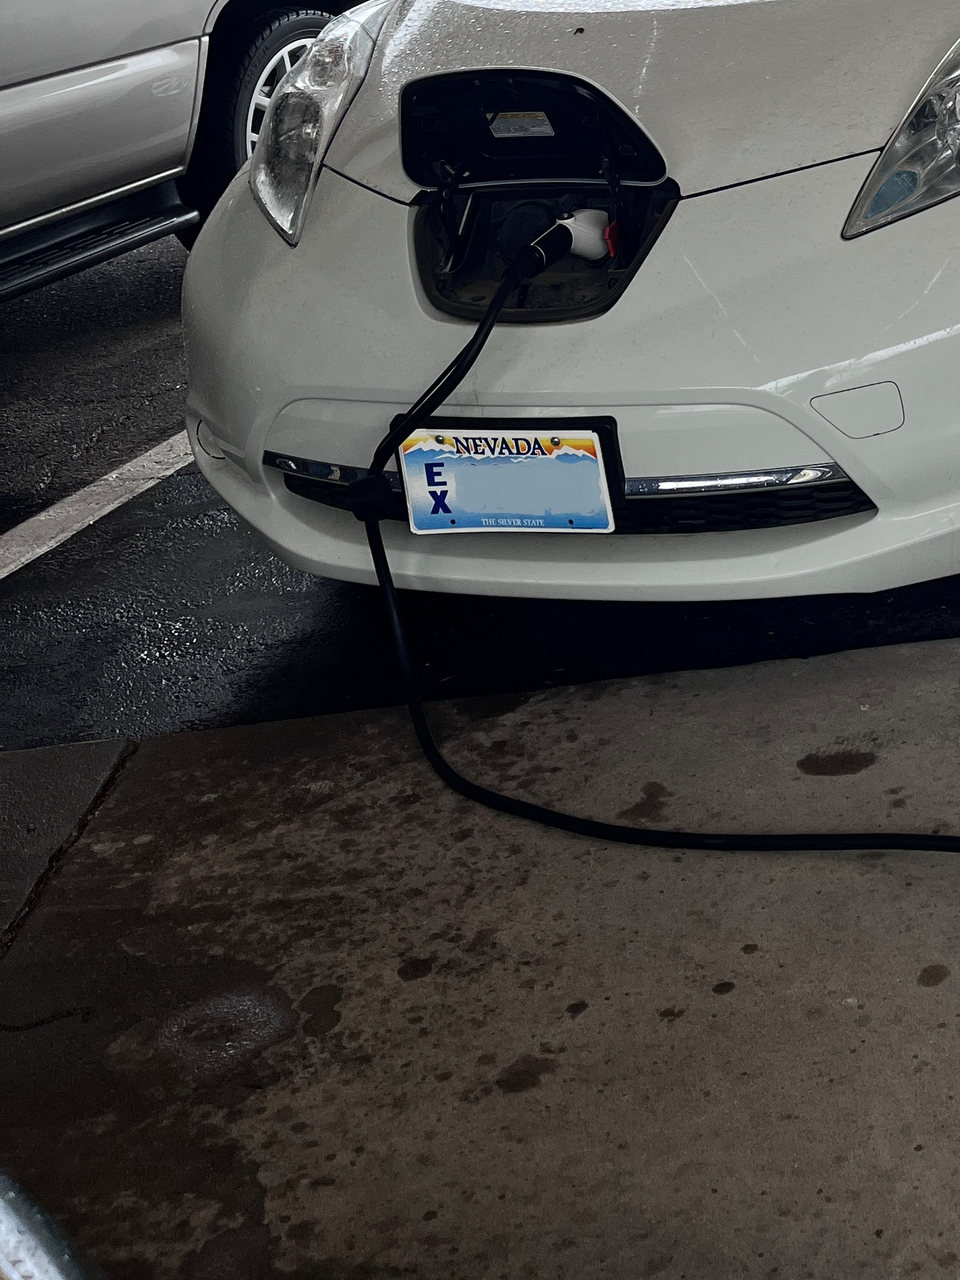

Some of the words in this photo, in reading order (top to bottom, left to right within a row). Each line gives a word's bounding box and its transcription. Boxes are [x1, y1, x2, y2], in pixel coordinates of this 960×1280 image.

[452, 436, 548, 456] NEVADA
[481, 518, 496, 526] THE
[497, 518, 522, 526] SILVER
[522, 518, 545, 527] STATE
